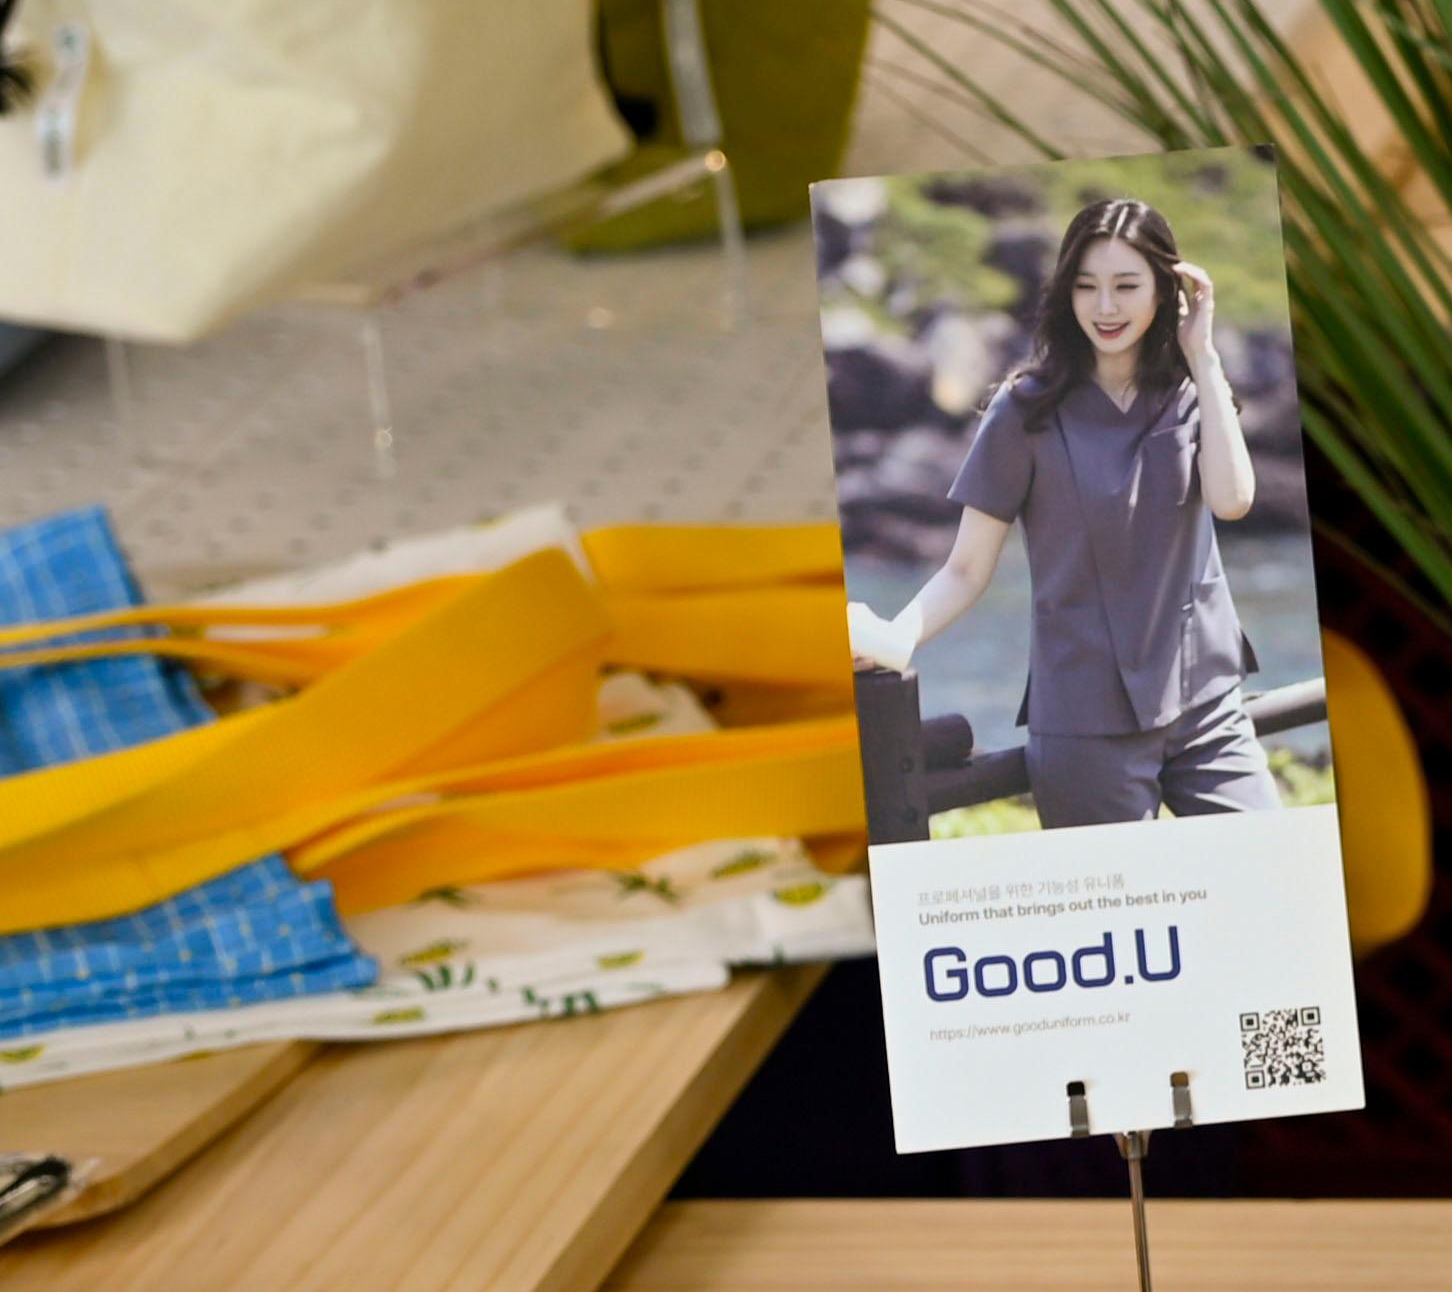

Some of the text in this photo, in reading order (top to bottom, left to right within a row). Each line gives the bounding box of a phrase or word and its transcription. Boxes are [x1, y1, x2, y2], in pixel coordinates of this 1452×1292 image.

[918, 888, 1208, 927] Uniform that brings out the best in you
[923, 925, 1183, 1002] Good.U
